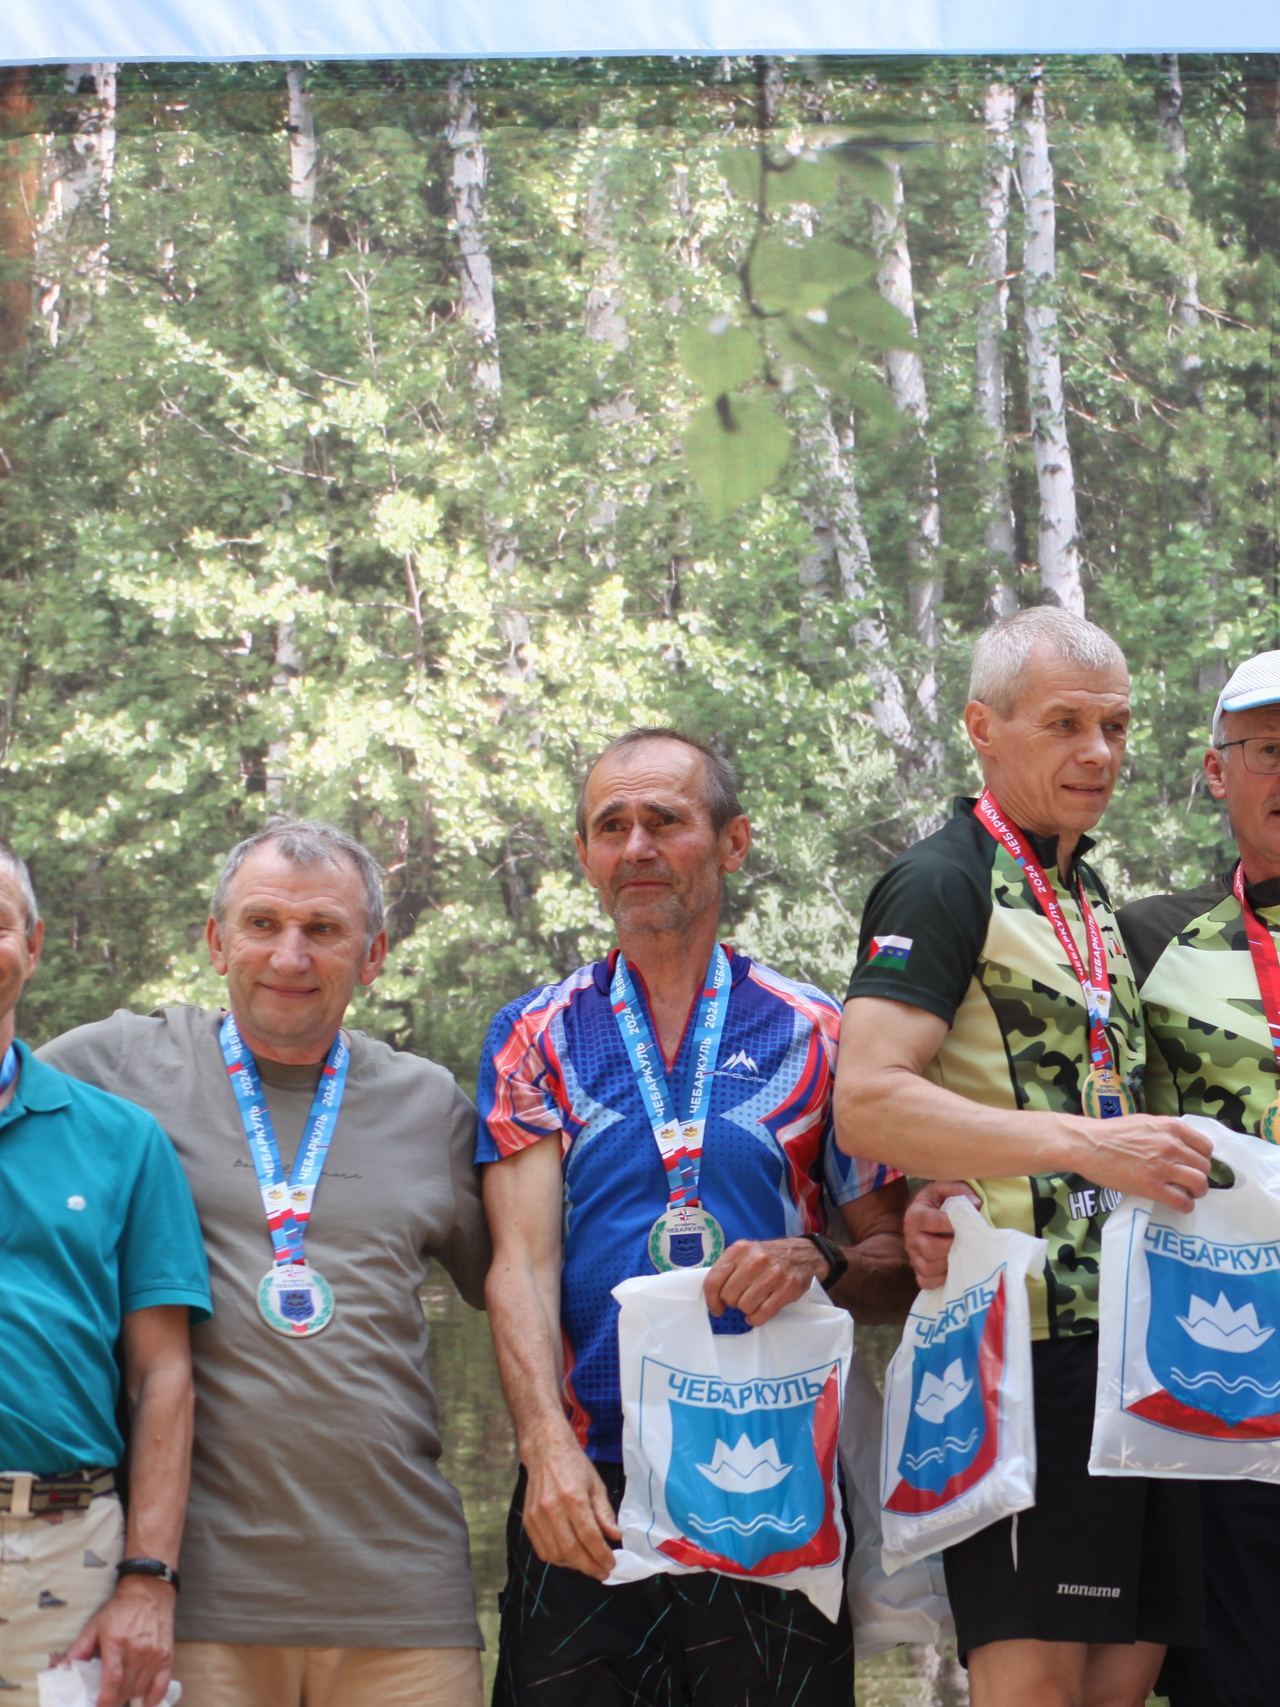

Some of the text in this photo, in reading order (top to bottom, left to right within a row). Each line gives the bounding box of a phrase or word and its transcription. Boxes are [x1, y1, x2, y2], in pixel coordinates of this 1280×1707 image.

[981, 799, 1084, 976] ЧЕБАРКУЛЬ 2024 ЧЕБАРКУЛЬ
[1088, 914, 1103, 981] ЧЕБАРКУЛЬ
[622, 1007, 640, 1035] 2024
[238, 1069, 256, 1096] 2024
[636, 1042, 664, 1117] ЧЕБАРКУЛЬ
[689, 1037, 712, 1114] ЧЕБАРКУЛЬ
[705, 1001, 719, 1029] 2024
[250, 1105, 274, 1178] ЧЕБАРКУЛЬ
[299, 1113, 328, 1180] ЧЕБАРКУЛЬ
[322, 1079, 337, 1107] 2024
[1068, 1189, 1096, 1220] НЕ
[668, 1373, 823, 1409] ЧЕБАРКУЛЬ
[1056, 1583, 1121, 1598] noname
